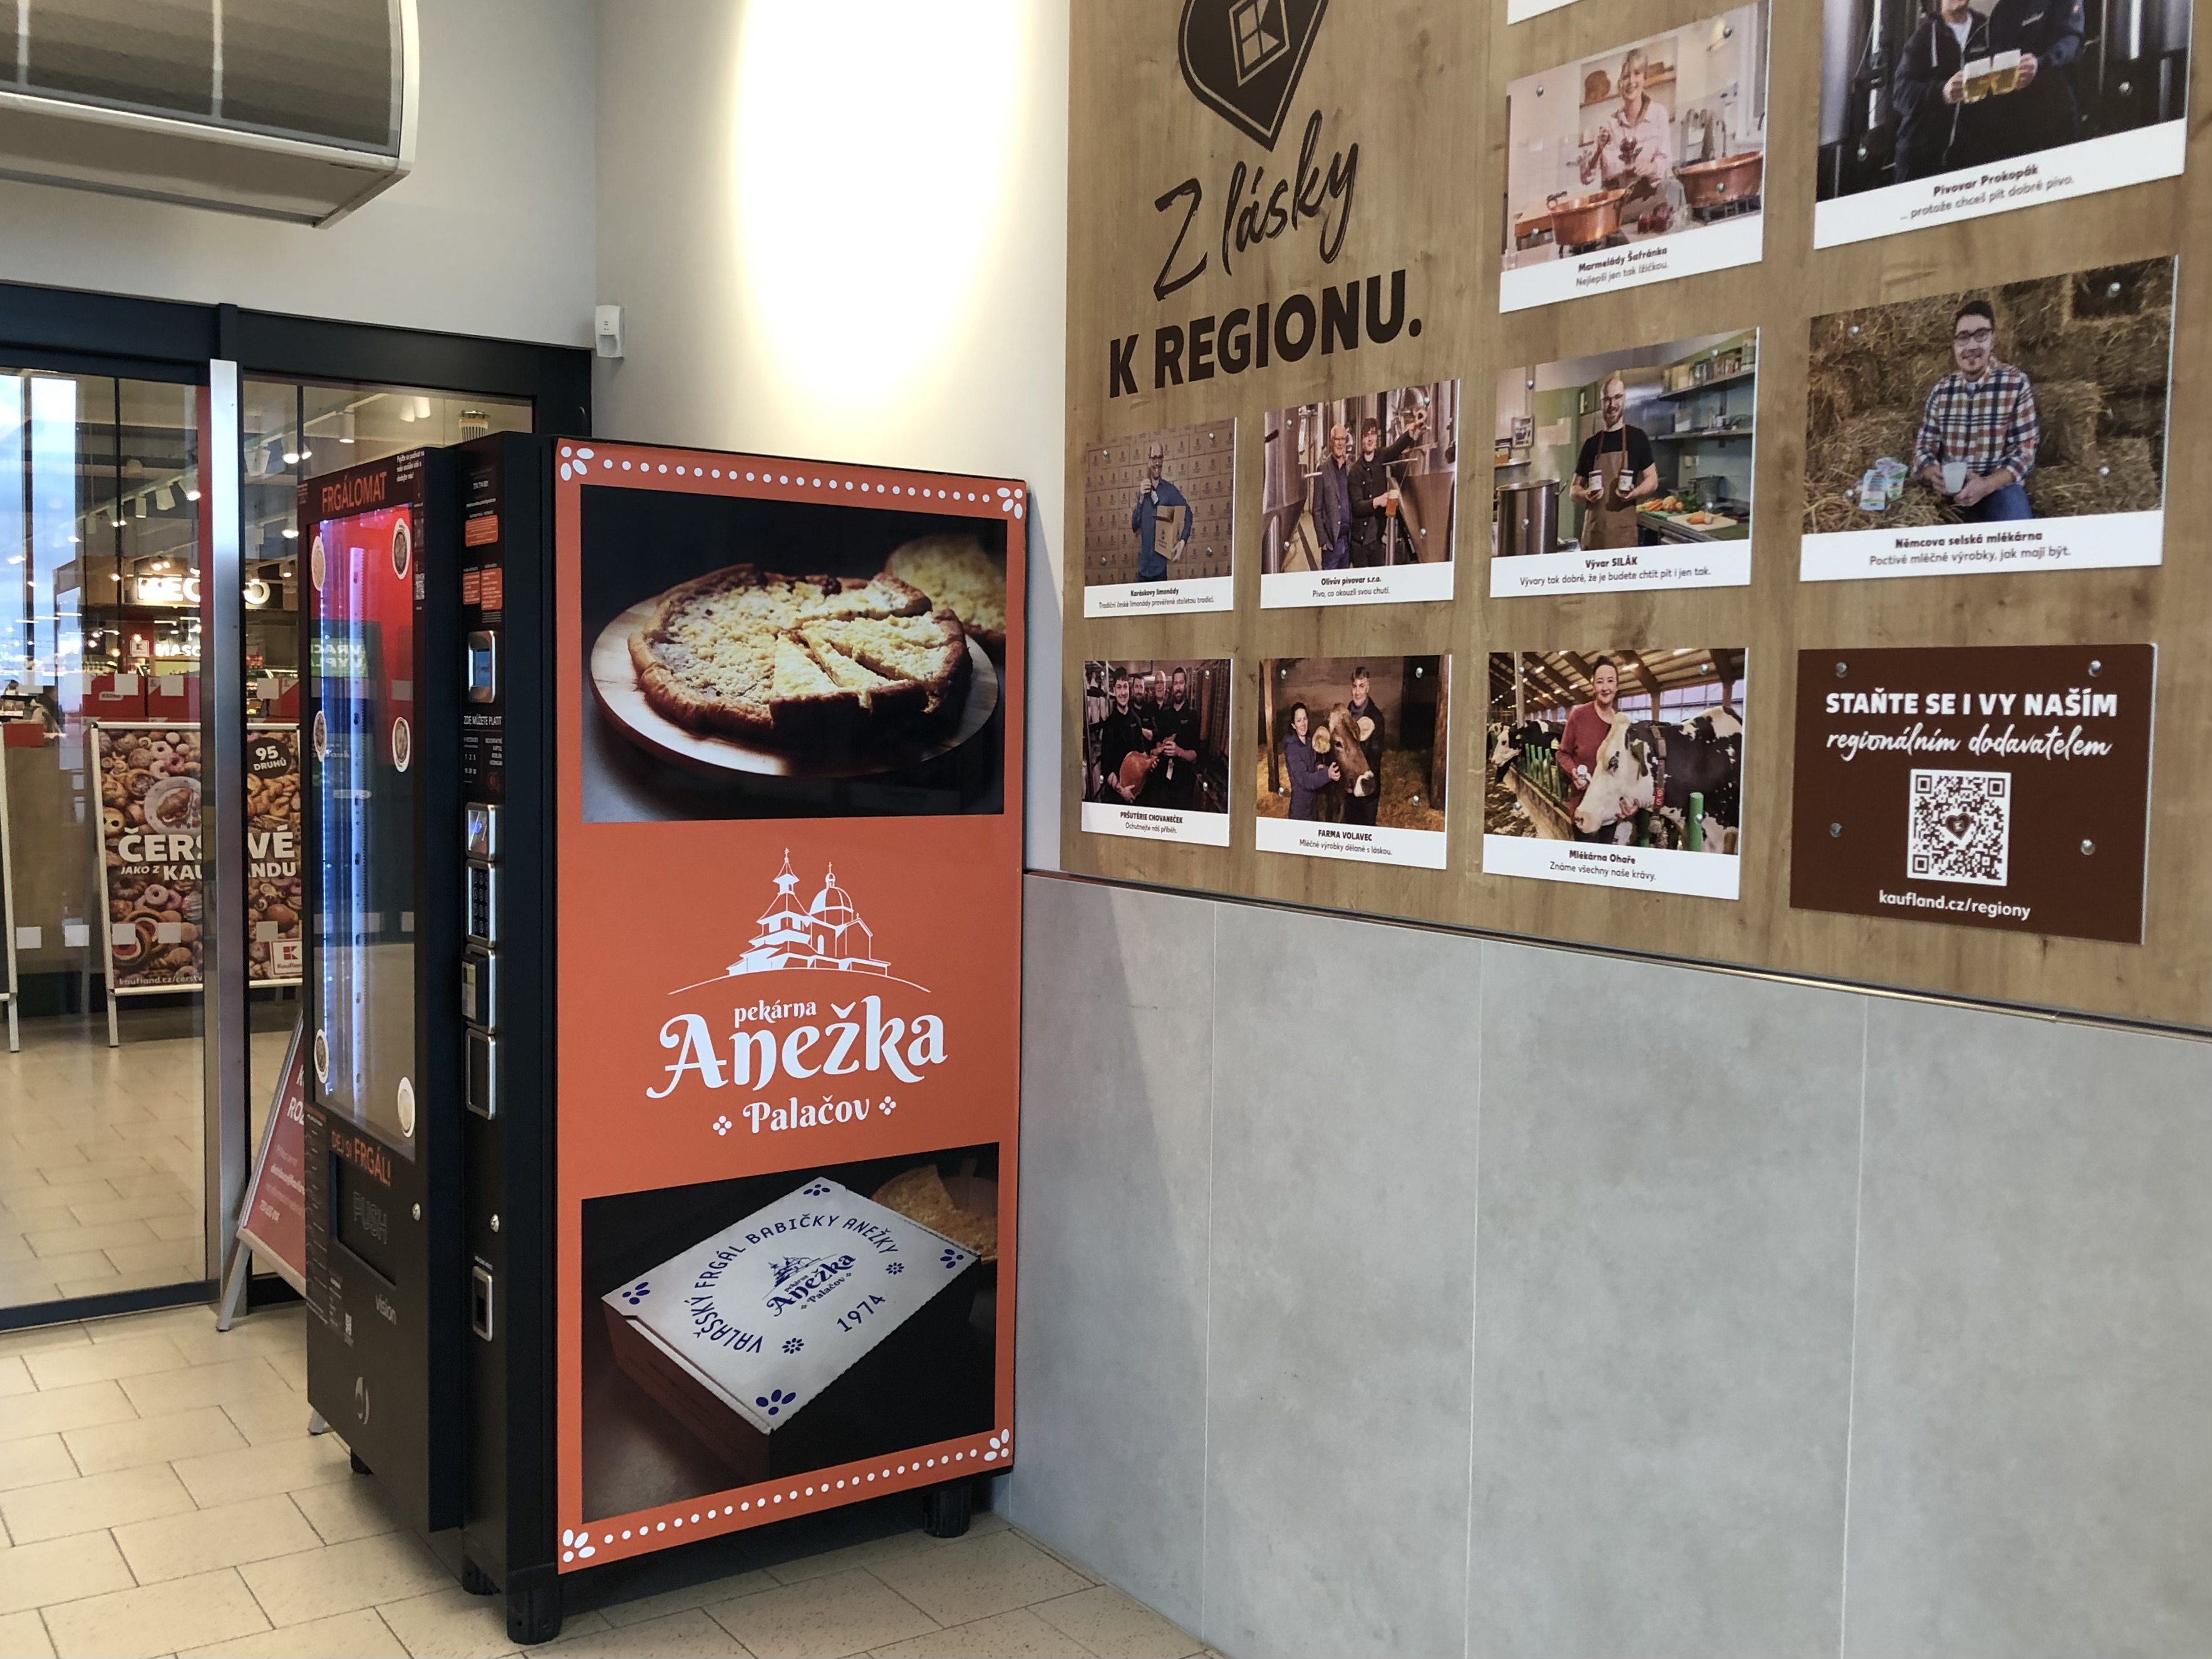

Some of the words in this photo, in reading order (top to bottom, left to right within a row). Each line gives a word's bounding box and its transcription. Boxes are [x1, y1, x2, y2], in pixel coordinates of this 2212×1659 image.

[1933, 178, 1977, 197] Pivovar
[1980, 163, 2039, 187] Prokopák
[1153, 178, 1208, 302] Z
[1222, 109, 1360, 276] lásky
[1911, 200, 1953, 219] protože
[1955, 192, 1987, 209] chceš
[1988, 189, 2006, 202] pít
[2008, 180, 2044, 197] dobré
[2046, 175, 2074, 192] pivo.
[1578, 256, 1625, 272] Marmelády
[1628, 246, 1668, 262] Šafránka
[1576, 271, 1607, 287] Nejlepší
[1608, 271, 1621, 282] jen
[1623, 266, 1636, 277] tak
[1108, 334, 1139, 398] K
[1154, 269, 1422, 390] REGIONU.
[322, 471, 387, 513] FRGÁLOMAT
[1894, 537, 1945, 549] Němcova
[1948, 534, 1983, 546] selská
[1986, 531, 2043, 543] mlékárna
[1585, 559, 1610, 570] Vývar
[1611, 554, 1638, 567] SILÁK
[1869, 554, 1908, 566] Poctivé
[1910, 551, 1949, 564] mléčné
[1951, 549, 1998, 564] výrobky,
[1999, 549, 2017, 562] jak
[2020, 547, 2045, 560] mají
[2048, 545, 2071, 559] být.
[1321, 577, 1341, 586] Olivův
[1342, 577, 1366, 586] pivovar
[1519, 576, 1546, 587] Vývary
[1547, 574, 1559, 584] tak
[1561, 574, 1586, 584] dobré,
[1588, 572, 1597, 582] že
[1598, 572, 1606, 584] je
[1608, 571, 1637, 581] budete
[1639, 569, 1659, 579] chtít
[1660, 568, 1673, 581] pít
[1678, 567, 1692, 579] jen
[1694, 566, 1712, 576] tak.
[1130, 589, 1155, 597] Karáskovy
[1156, 587, 1179, 596] limonády
[1313, 590, 1326, 598] Pivo,
[1336, 587, 1357, 597] okouzlí
[1826, 687, 1919, 715] STAŇTE
[1925, 693, 1956, 715] SE
[1963, 693, 1970, 715] I
[1979, 693, 2017, 716] VY
[2023, 687, 2117, 717] NAŠÍM
[256, 745, 279, 761] 95
[1826, 722, 1962, 762] regionálním
[1968, 722, 2114, 761] dodavatelem
[253, 757, 287, 771] DRUHŮ
[1120, 810, 1147, 820] PRŠUTÉRIE
[1149, 814, 1183, 824] CHOVANEČEK
[1125, 822, 1150, 832] Ochutnejte
[1300, 839, 1319, 849] Mléčné
[1321, 842, 1343, 852] výrobky
[1345, 844, 1365, 853] dělané
[1371, 847, 1393, 855] láskou.
[1318, 829, 1340, 839] FARMA
[1342, 831, 1373, 841] VOLAVEC
[121, 866, 150, 875] JAKO
[152, 865, 160, 874] Z
[1569, 850, 1608, 862] Mlékárna
[1609, 854, 1636, 864] Ohaře
[1549, 861, 1576, 872] Známe
[1578, 865, 1609, 877] všechny
[1611, 868, 1630, 877] naše
[1632, 869, 1656, 882] krávy.
[1878, 889, 2032, 921] kaufland.cz/regiony
[733, 998, 817, 1028] pekárna
[646, 995, 949, 1099] Anežka
[743, 1094, 871, 1134] Palačov
[332, 1130, 344, 1154] DEJ
[354, 1137, 391, 1187] FRGÁL!
[353, 1191, 387, 1245] PUSH
[745, 1213, 840, 1244] BABIČKY
[842, 1217, 898, 1254] ANEŽKY
[694, 1245, 747, 1288] FRGÁL
[767, 1254, 856, 1317] Anežka
[784, 1274, 809, 1293] pekárna
[807, 1277, 845, 1303] Palačov
[684, 1295, 764, 1353] VALAŠSKÝ
[837, 1293, 886, 1333] 1974
